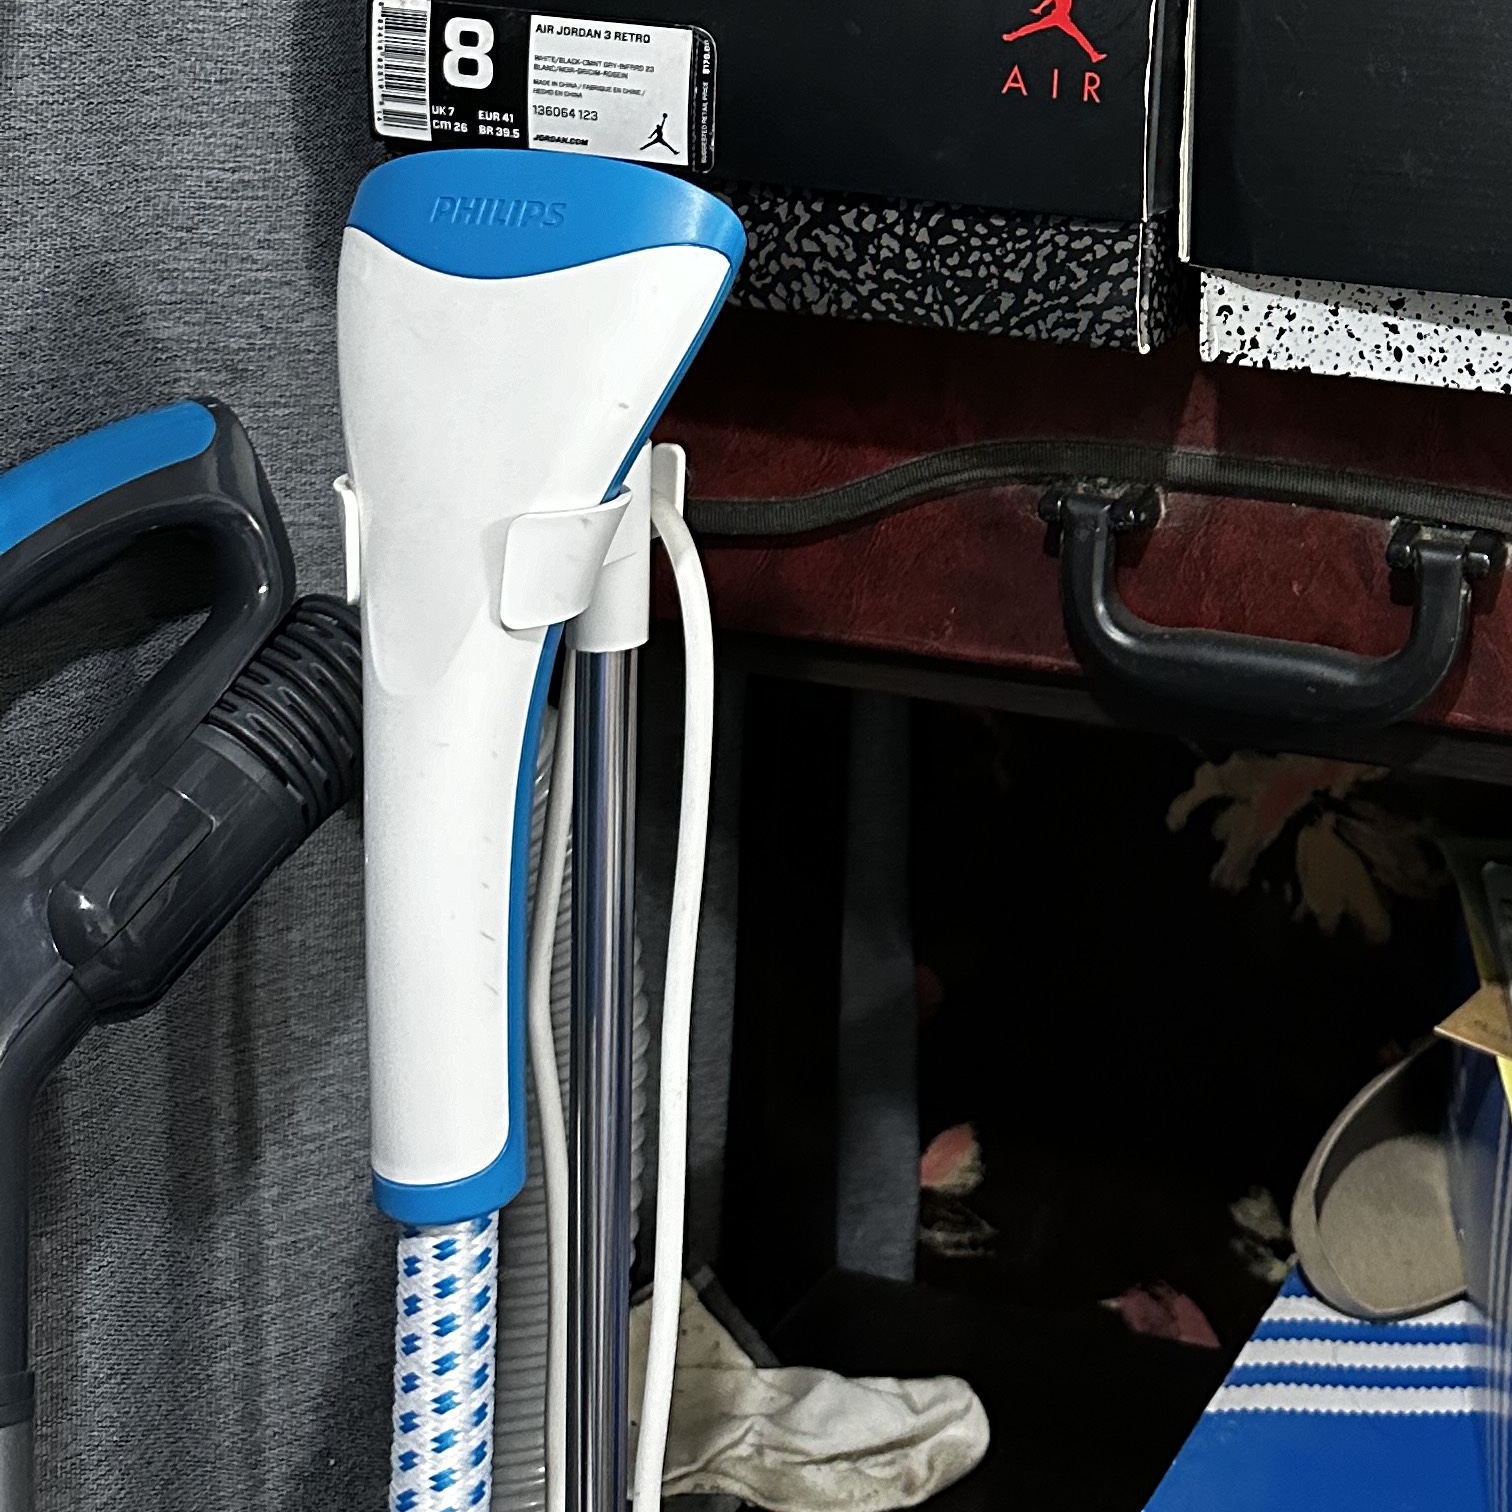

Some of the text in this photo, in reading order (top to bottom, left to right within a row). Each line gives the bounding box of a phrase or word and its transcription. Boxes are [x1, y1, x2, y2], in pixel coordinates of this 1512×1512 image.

[536, 24, 651, 44] AIR JORDAN 3 RETRO
[443, 17, 494, 89] 8
[1001, 64, 1100, 103] AIR
[432, 104, 513, 123] UK 7 EUR 41
[533, 105, 598, 121] 136064 123
[454, 122, 468, 132] 26
[479, 125, 494, 135] BR
[429, 195, 567, 229] PHILIPS
